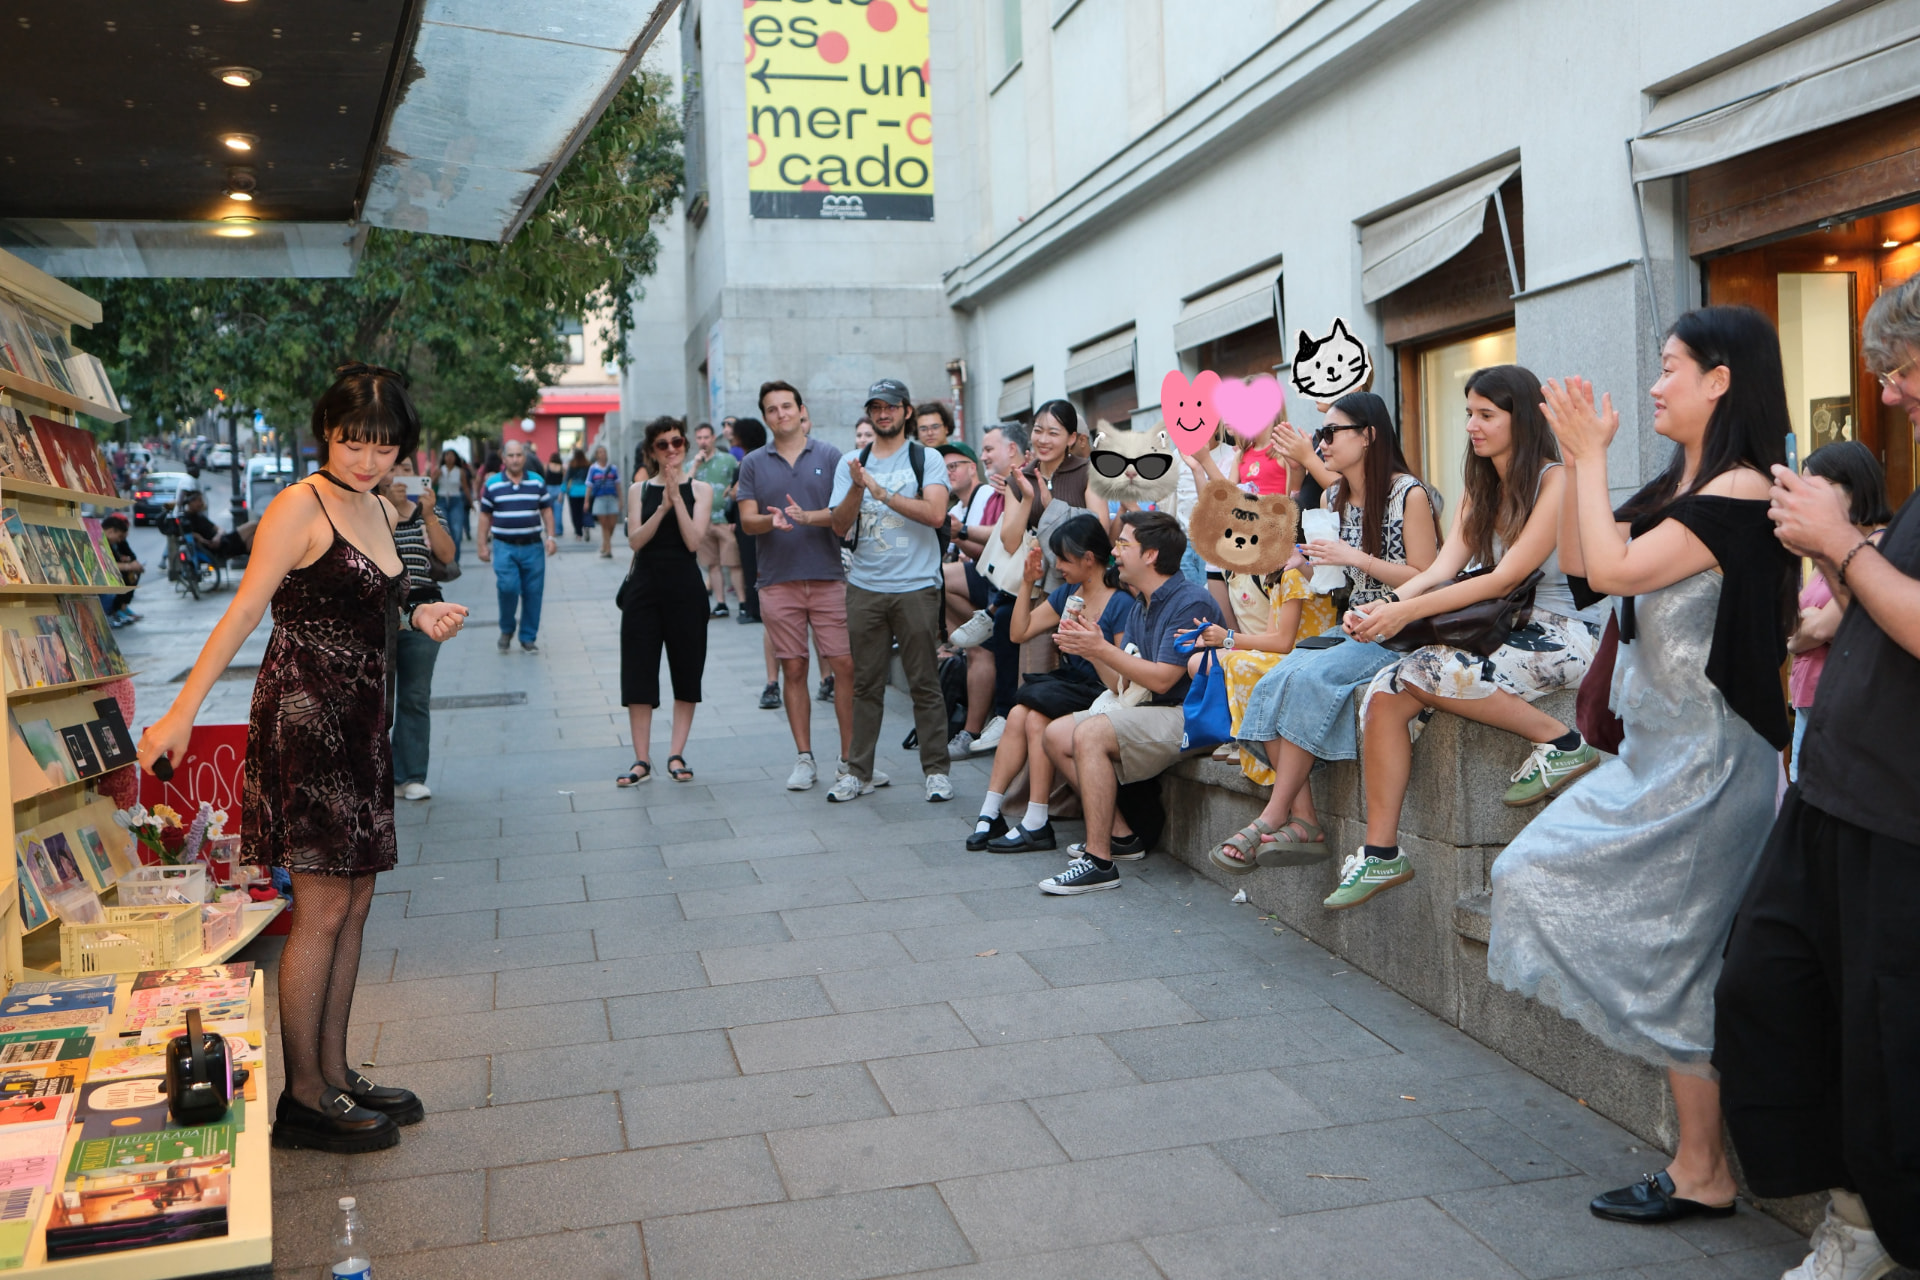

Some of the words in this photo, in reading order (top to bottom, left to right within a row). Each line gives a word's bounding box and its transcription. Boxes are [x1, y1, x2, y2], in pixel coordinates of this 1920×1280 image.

[749, 15, 819, 48] es
[860, 63, 926, 97] un
[751, 105, 901, 139] mer-
[778, 143, 929, 188] cado
